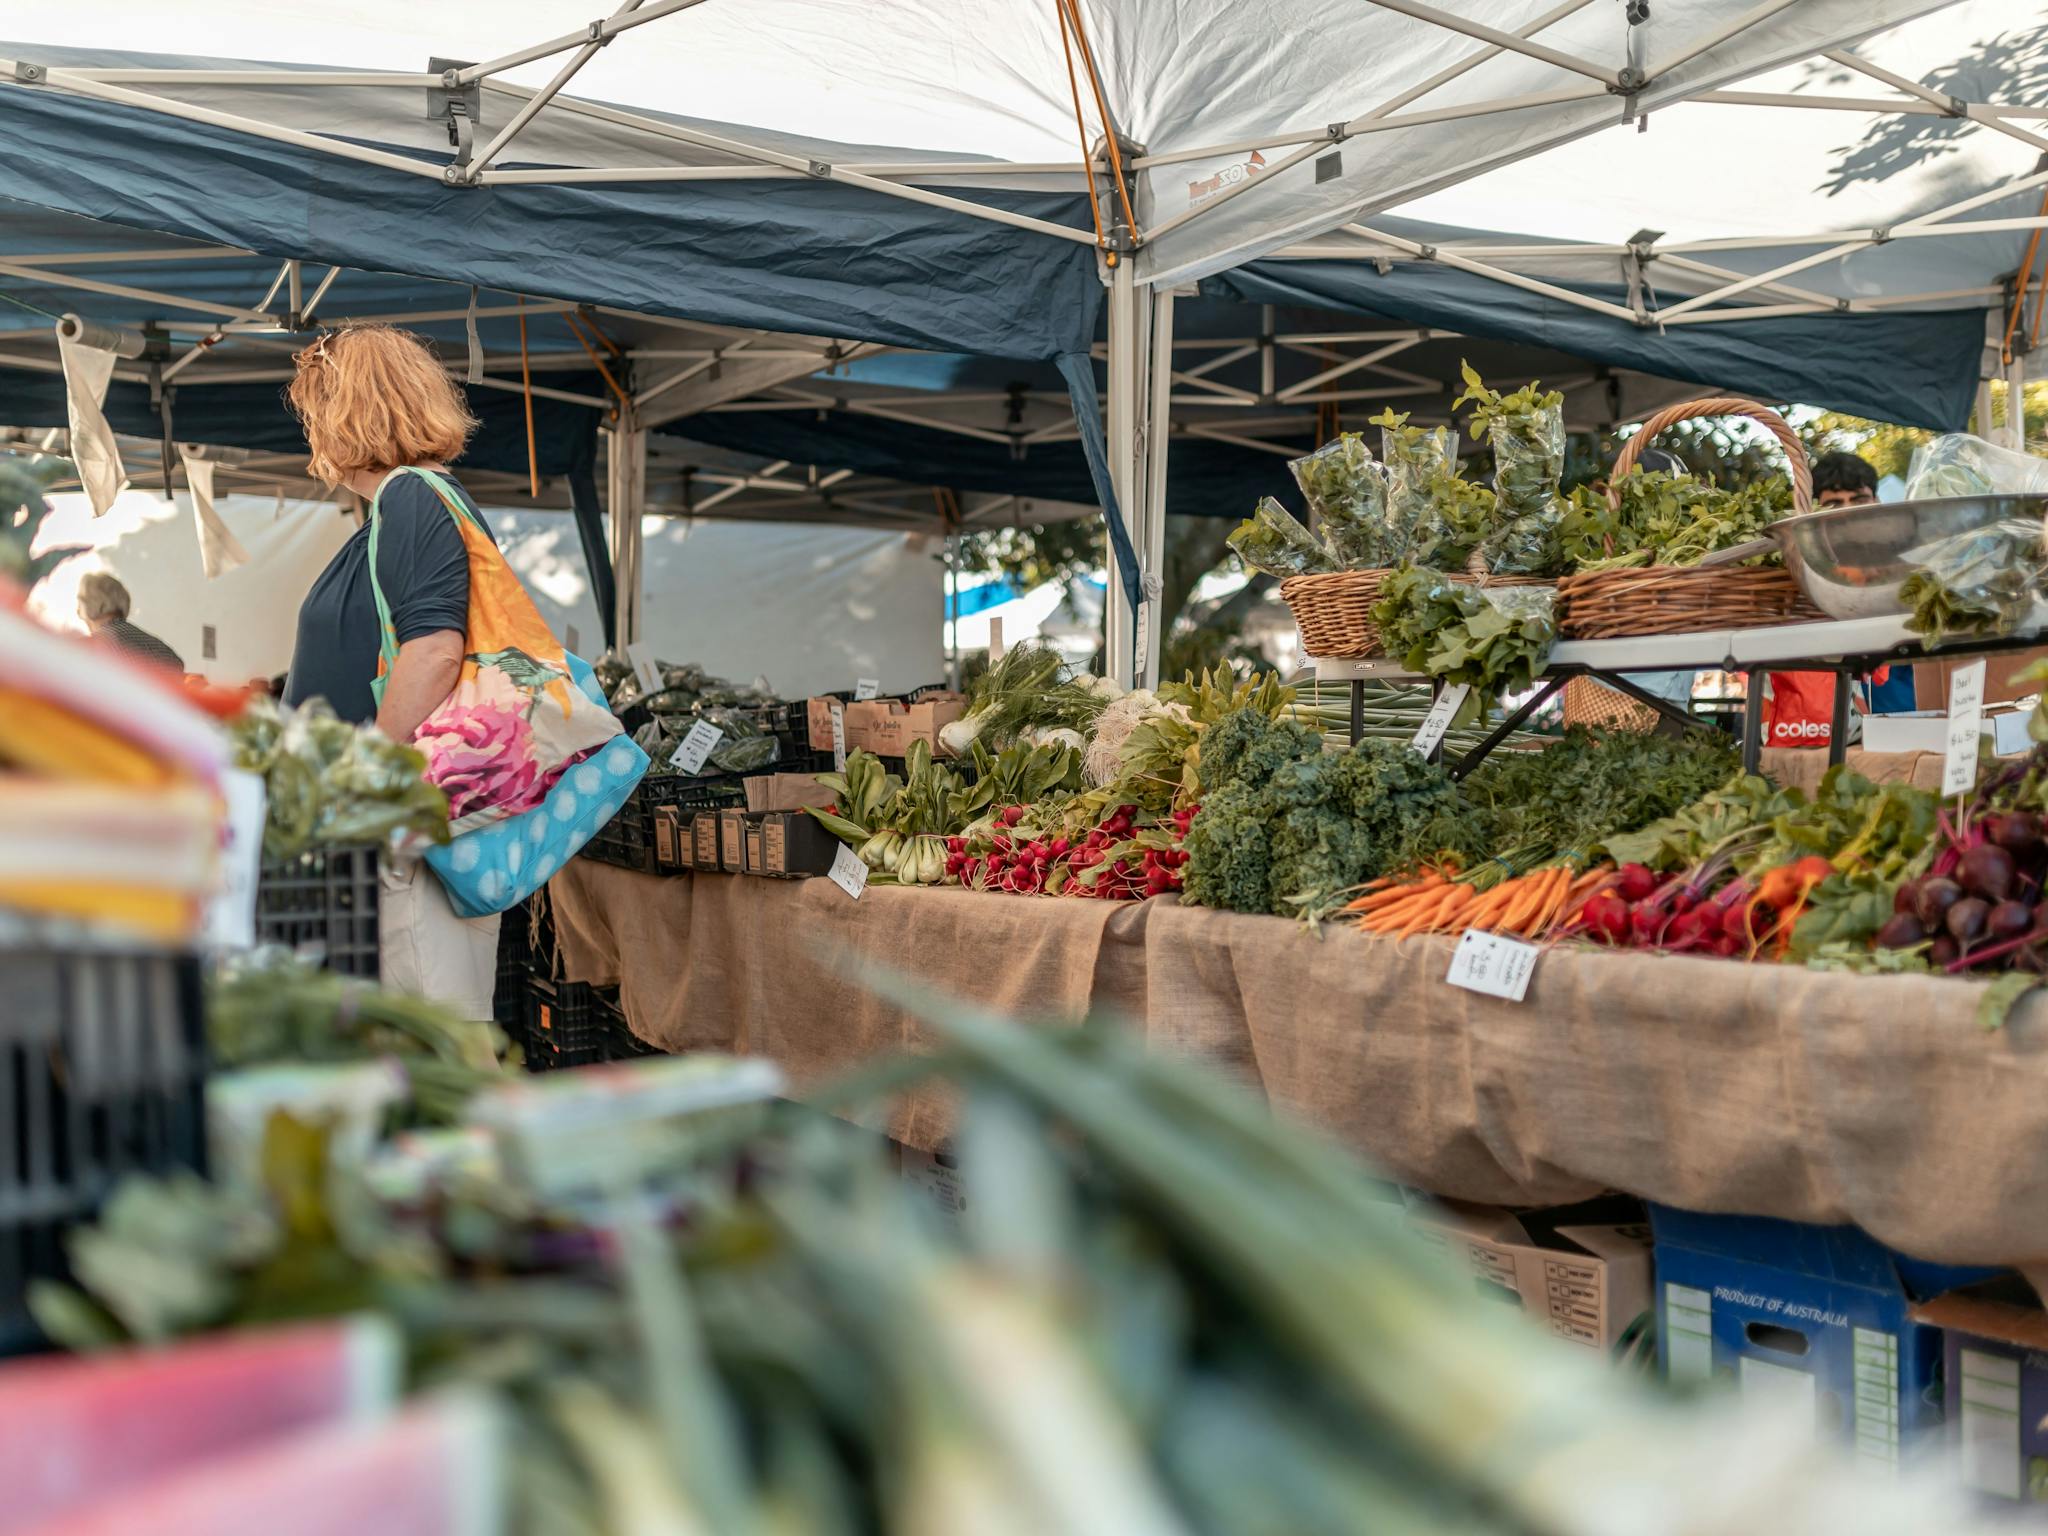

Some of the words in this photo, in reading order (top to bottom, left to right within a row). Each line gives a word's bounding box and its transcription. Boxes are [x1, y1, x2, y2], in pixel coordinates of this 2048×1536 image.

[1775, 719, 1830, 737] coles
[1713, 1286, 1767, 1308] PRODUCT
[1767, 1299, 1784, 1312] OF
[1784, 1302, 1848, 1327] AUSTRALIA
